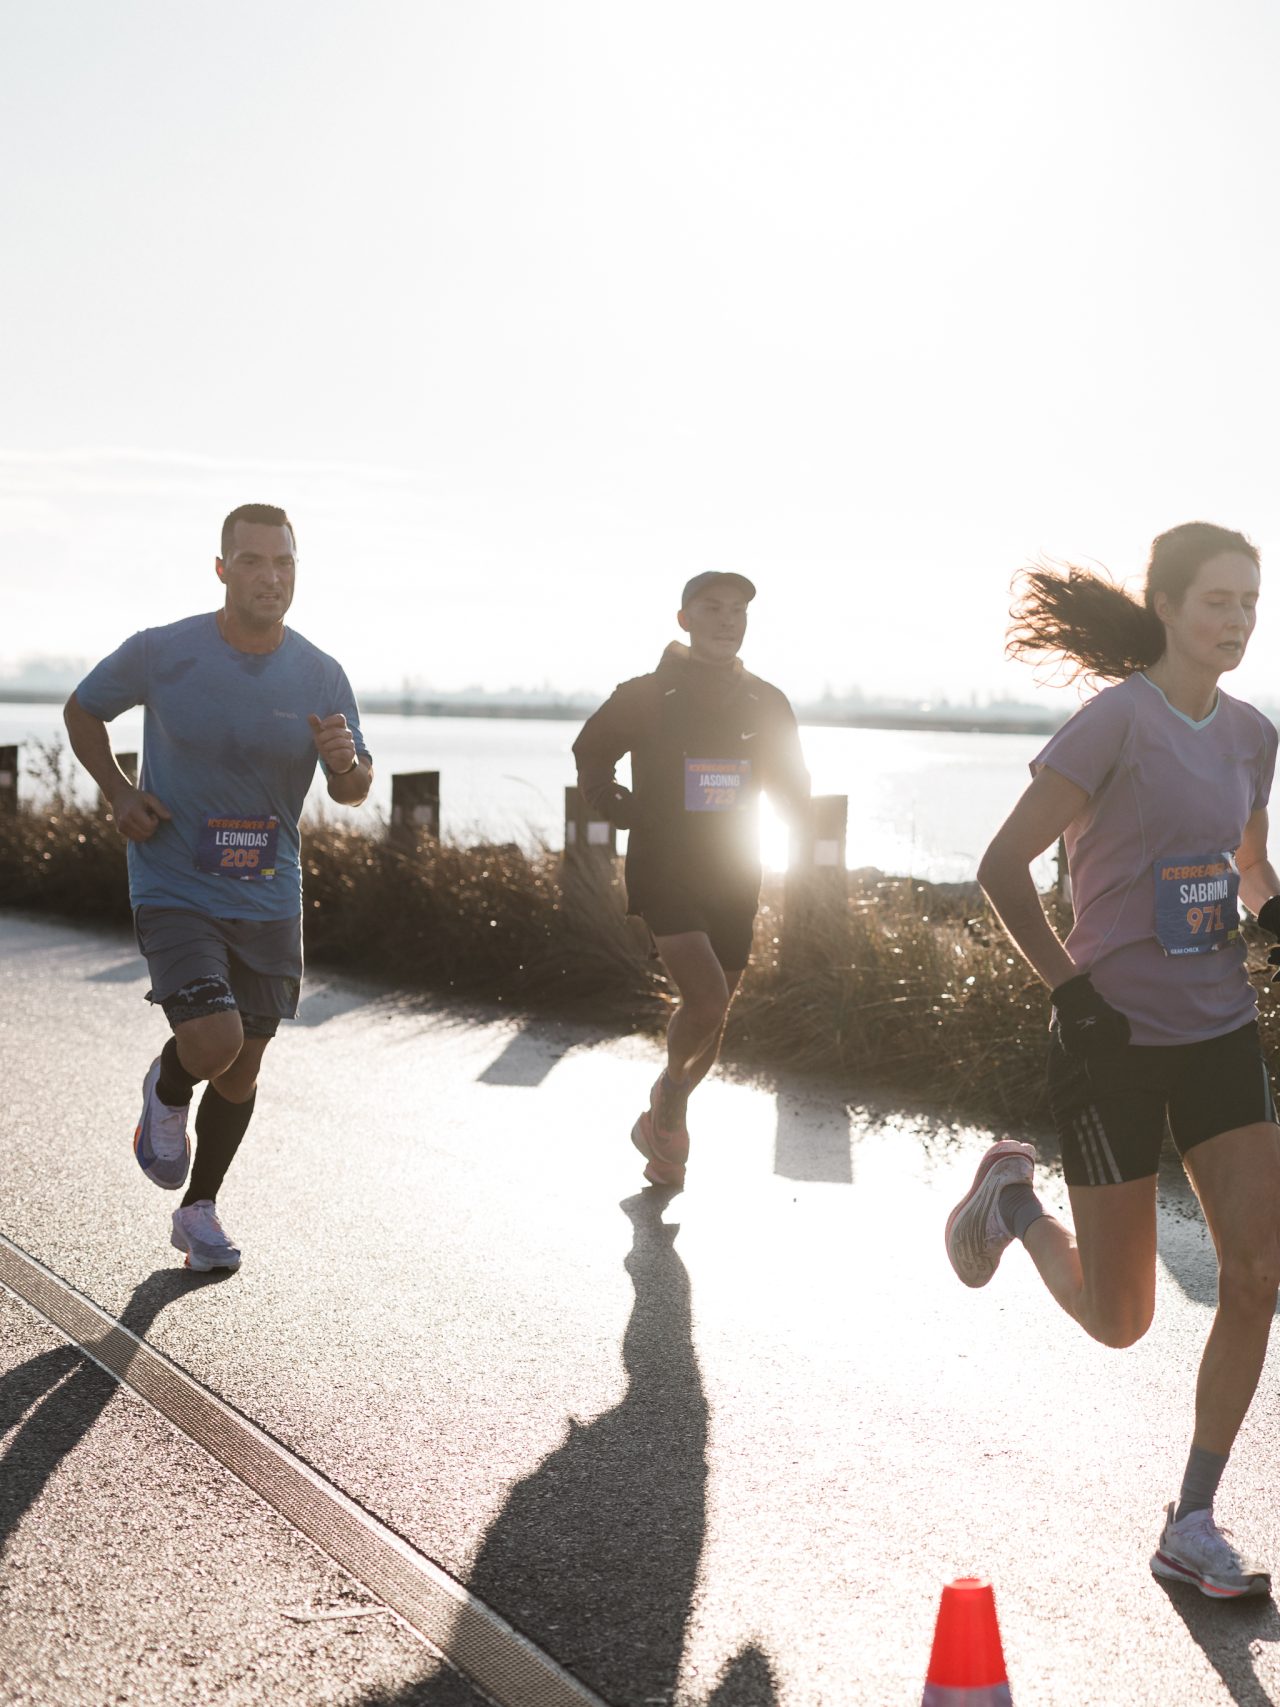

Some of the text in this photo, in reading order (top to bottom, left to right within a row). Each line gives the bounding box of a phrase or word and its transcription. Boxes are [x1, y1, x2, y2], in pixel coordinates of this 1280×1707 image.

[215, 831, 269, 848] LEONIDAS
[221, 848, 260, 868] 205
[1180, 879, 1228, 904] SABRINA
[1186, 904, 1225, 935] 971
